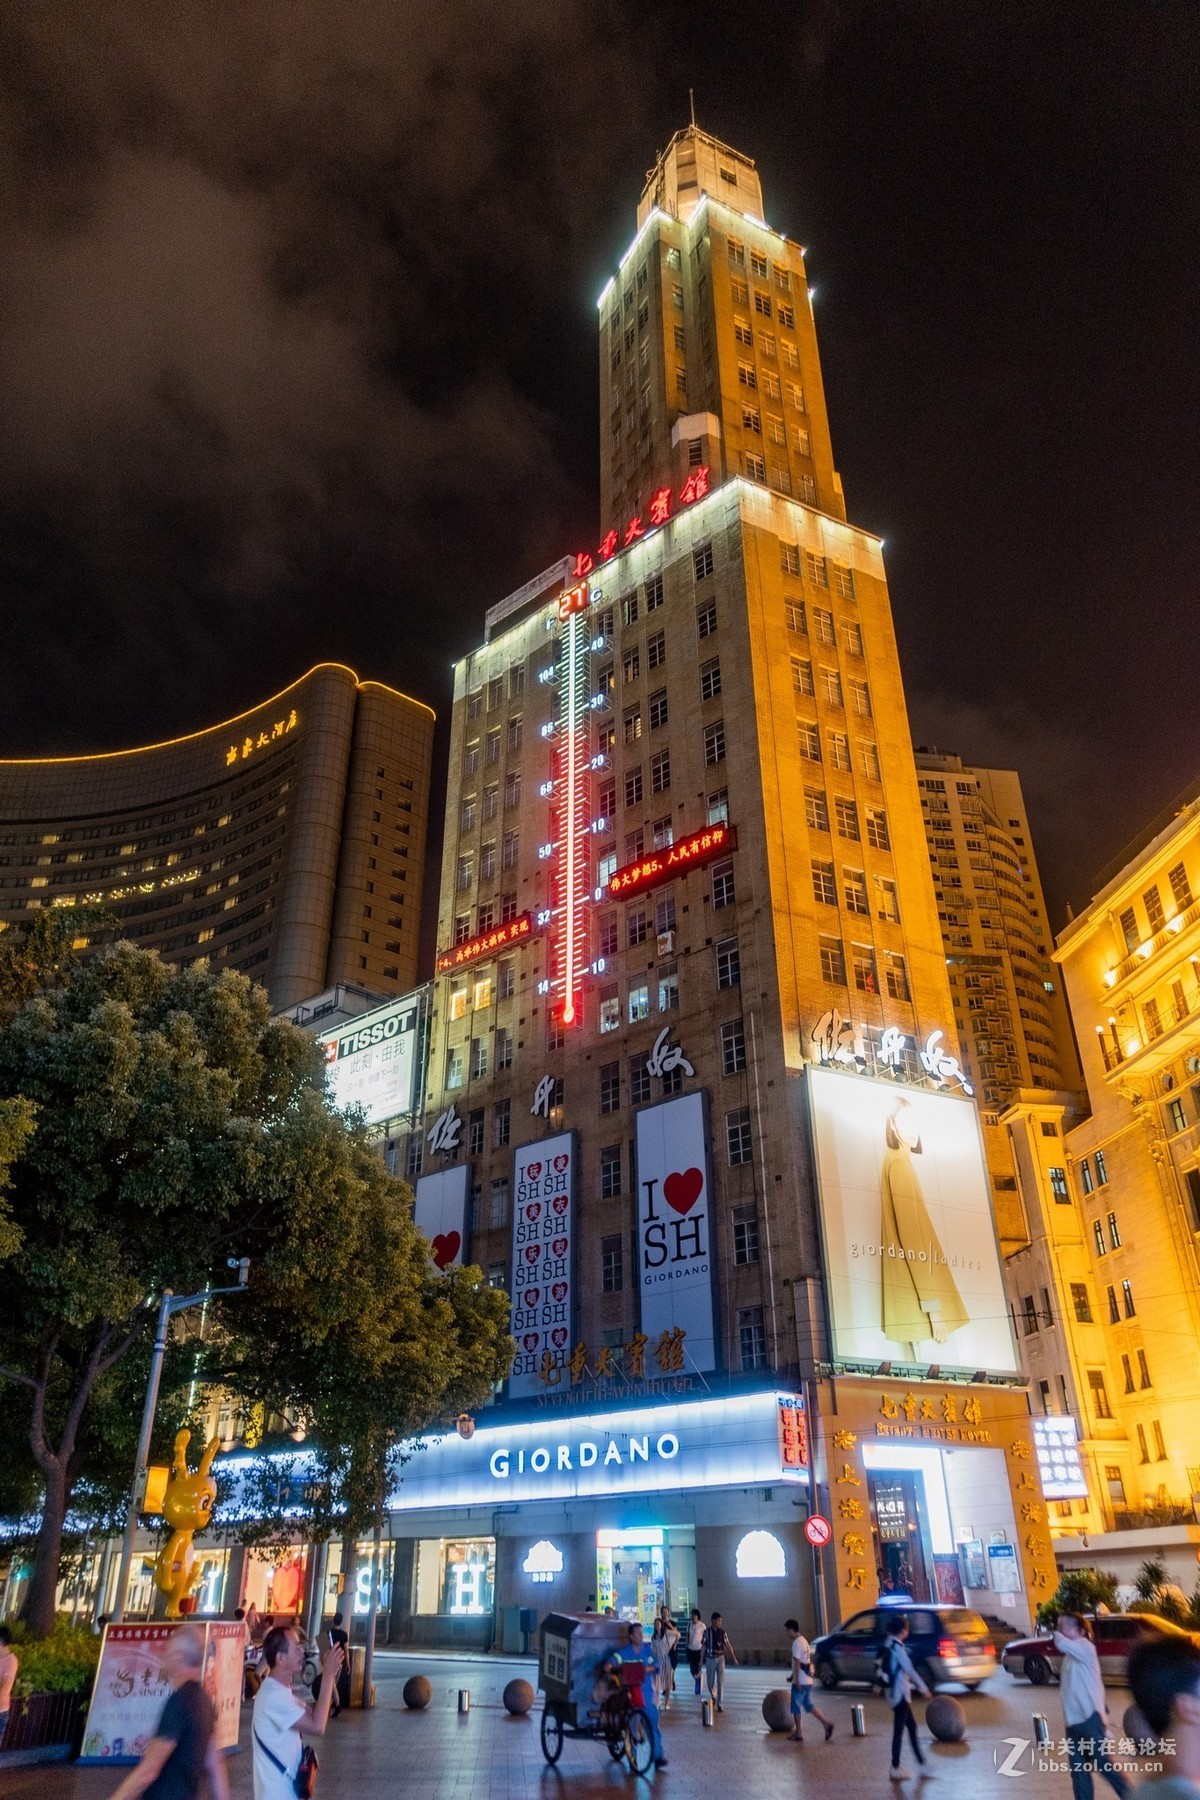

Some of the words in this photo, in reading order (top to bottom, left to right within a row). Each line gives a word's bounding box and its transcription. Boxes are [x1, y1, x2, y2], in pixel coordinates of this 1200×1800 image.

[546, 616, 556, 631] F
[591, 636, 604, 651] 40
[539, 665, 554, 684] 104
[590, 693, 604, 708] 30
[541, 721, 554, 737] 86
[591, 754, 604, 770] 20
[540, 780, 553, 796] 68
[592, 817, 605, 834] 10
[538, 843, 552, 859] 50
[594, 887, 602, 901] 0
[537, 909, 550, 926] 32
[592, 958, 605, 975] 10
[537, 979, 549, 995] 14
[341, 1009, 412, 1056] TISSOT
[812, 1008, 974, 1096] 佐丹奴
[519, 1166, 526, 1184] I
[545, 1159, 552, 1177] I
[517, 1180, 541, 1203] SH
[544, 1172, 568, 1196] SH
[544, 1199, 551, 1218] I
[642, 1178, 658, 1224] I
[518, 1206, 525, 1225] I
[543, 1214, 567, 1237] SH
[516, 1221, 540, 1244] SH
[644, 1213, 707, 1270] SH
[517, 1248, 524, 1267] I
[543, 1241, 551, 1261] I
[850, 1243, 928, 1265] giordano
[515, 1264, 540, 1287] SH
[542, 1258, 567, 1281] SH
[644, 1264, 709, 1286] GIORDANO
[516, 1291, 523, 1311] I
[543, 1285, 550, 1305] I
[514, 1308, 539, 1331] SH
[542, 1302, 567, 1326] SH
[542, 1330, 550, 1351] I
[513, 1353, 538, 1377] SH
[489, 1433, 680, 1479] GIORDANO
[204, 1570, 220, 1612] I
[450, 1564, 486, 1614] H
